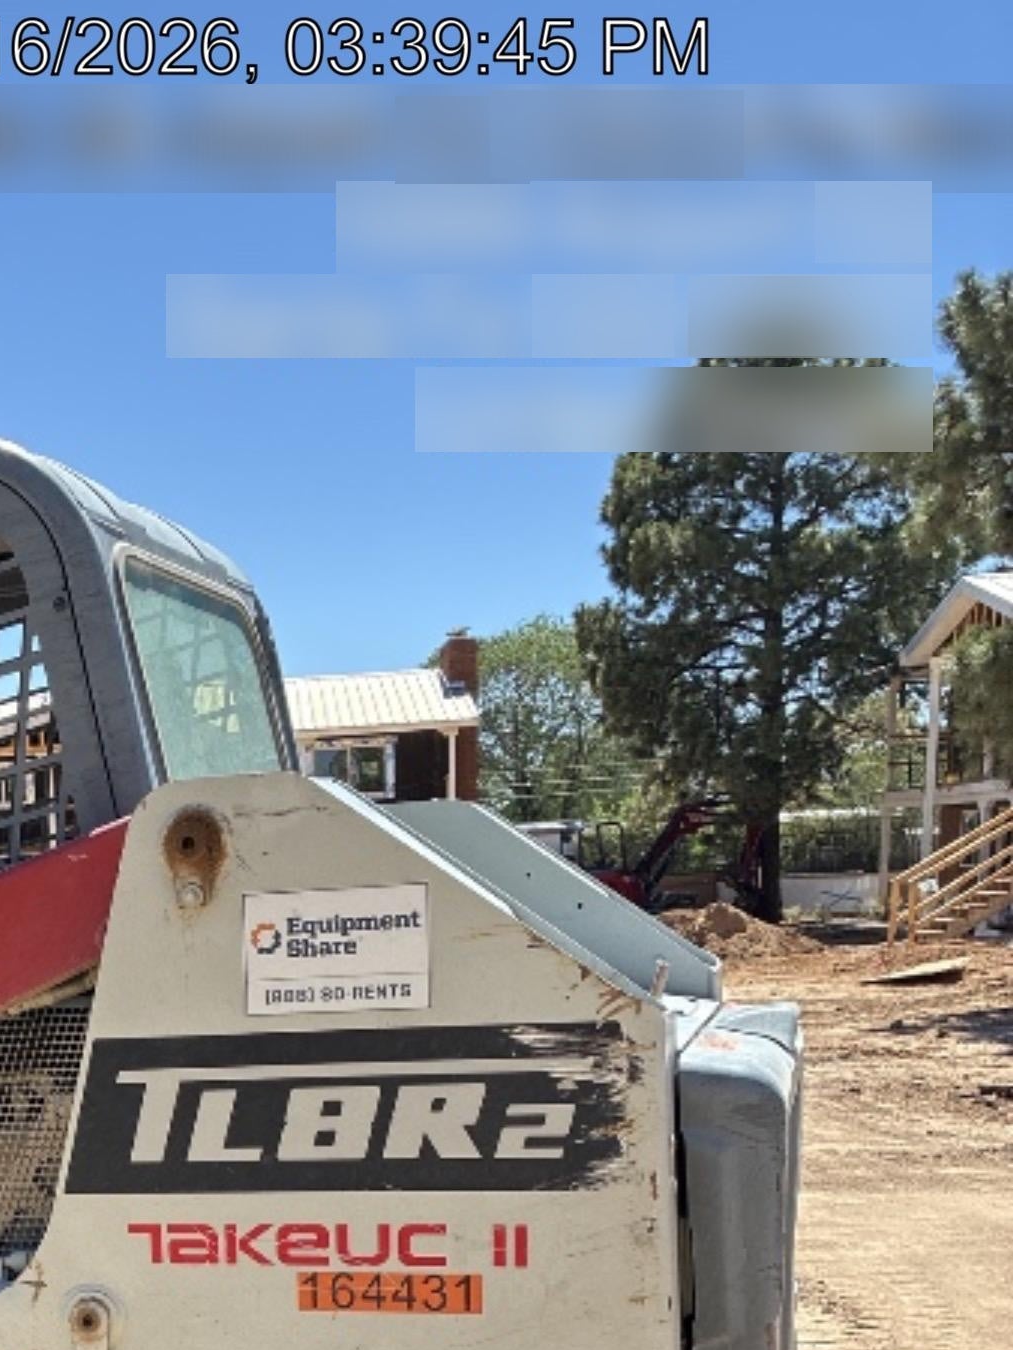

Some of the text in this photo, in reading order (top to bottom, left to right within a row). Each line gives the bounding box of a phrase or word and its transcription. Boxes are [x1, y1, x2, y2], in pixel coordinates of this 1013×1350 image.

[286, 911, 422, 937] Equipment
[286, 939, 357, 958] Share
[116, 1066, 577, 1163] TL8R2
[299, 1272, 474, 1312] 164431
